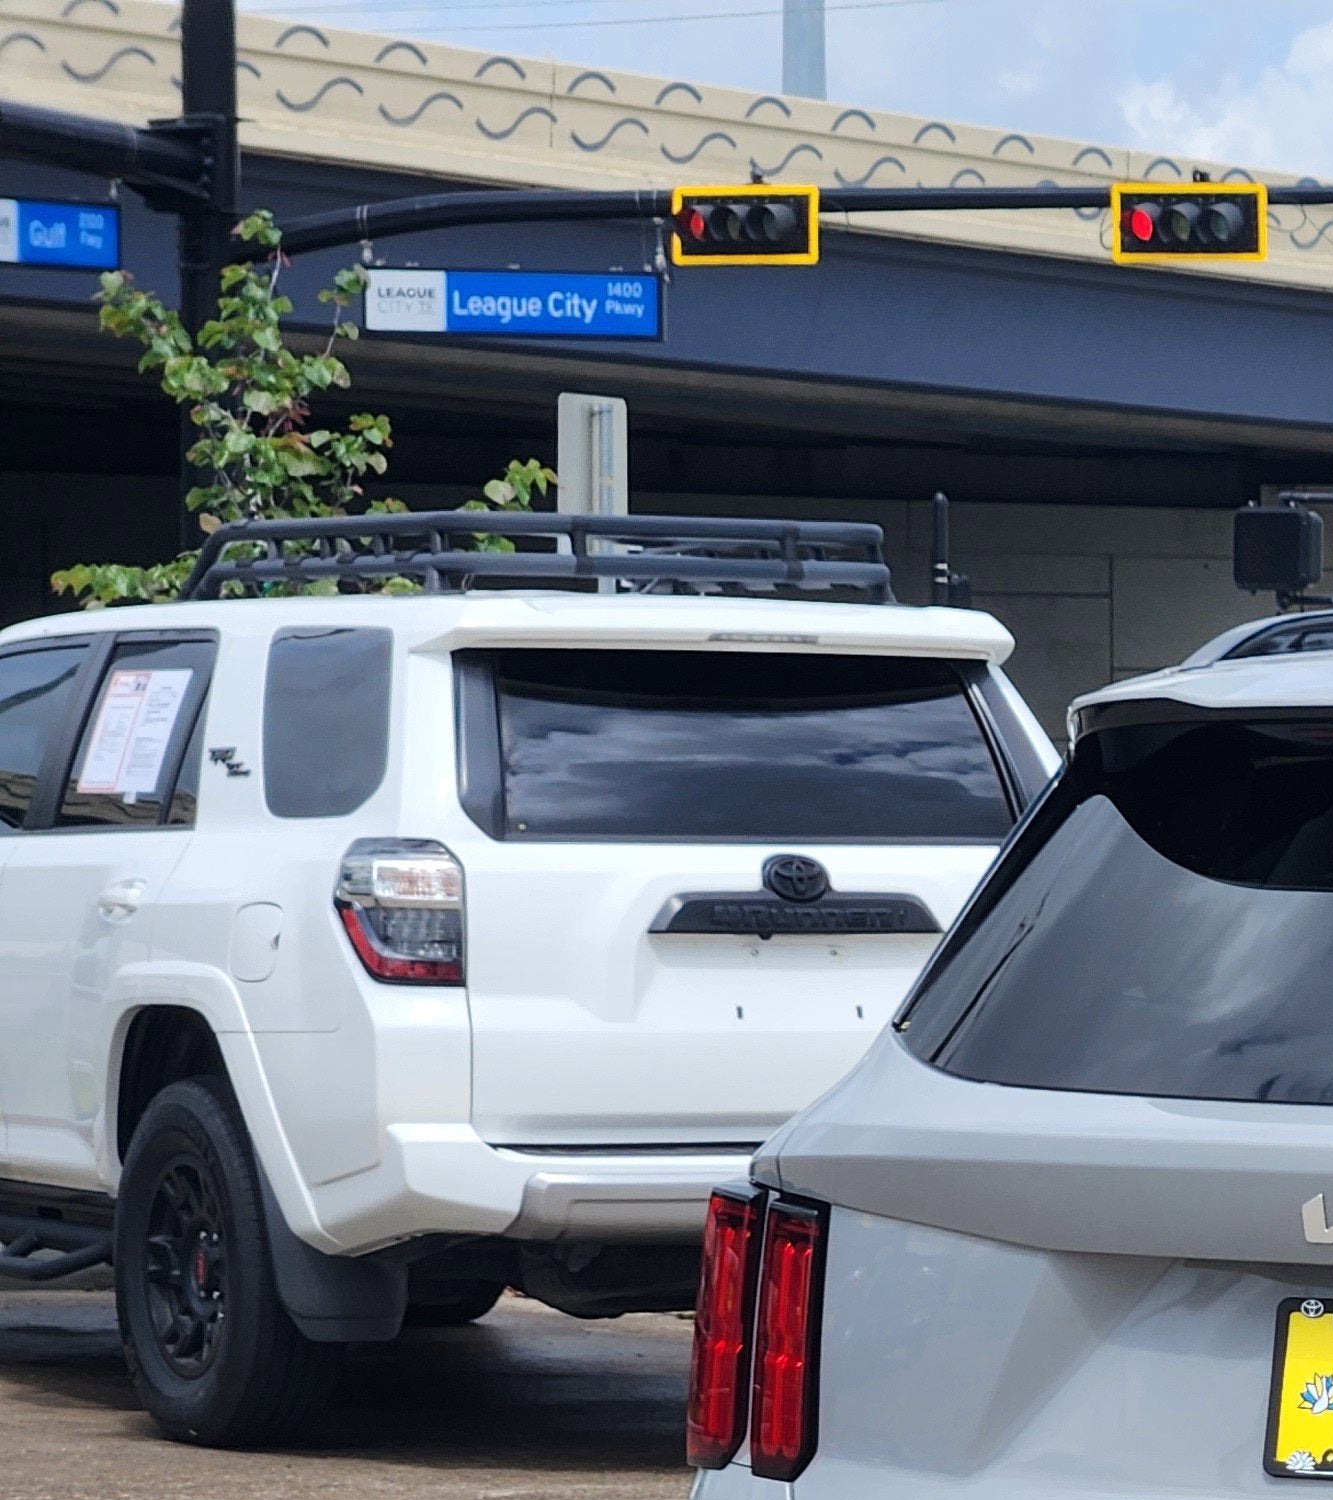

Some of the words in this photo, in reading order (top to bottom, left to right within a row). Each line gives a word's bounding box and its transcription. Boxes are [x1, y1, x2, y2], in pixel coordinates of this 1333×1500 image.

[29, 219, 66, 249] Gulf
[377, 287, 435, 299] LEAGUE
[453, 289, 542, 324] League
[548, 291, 598, 324] City
